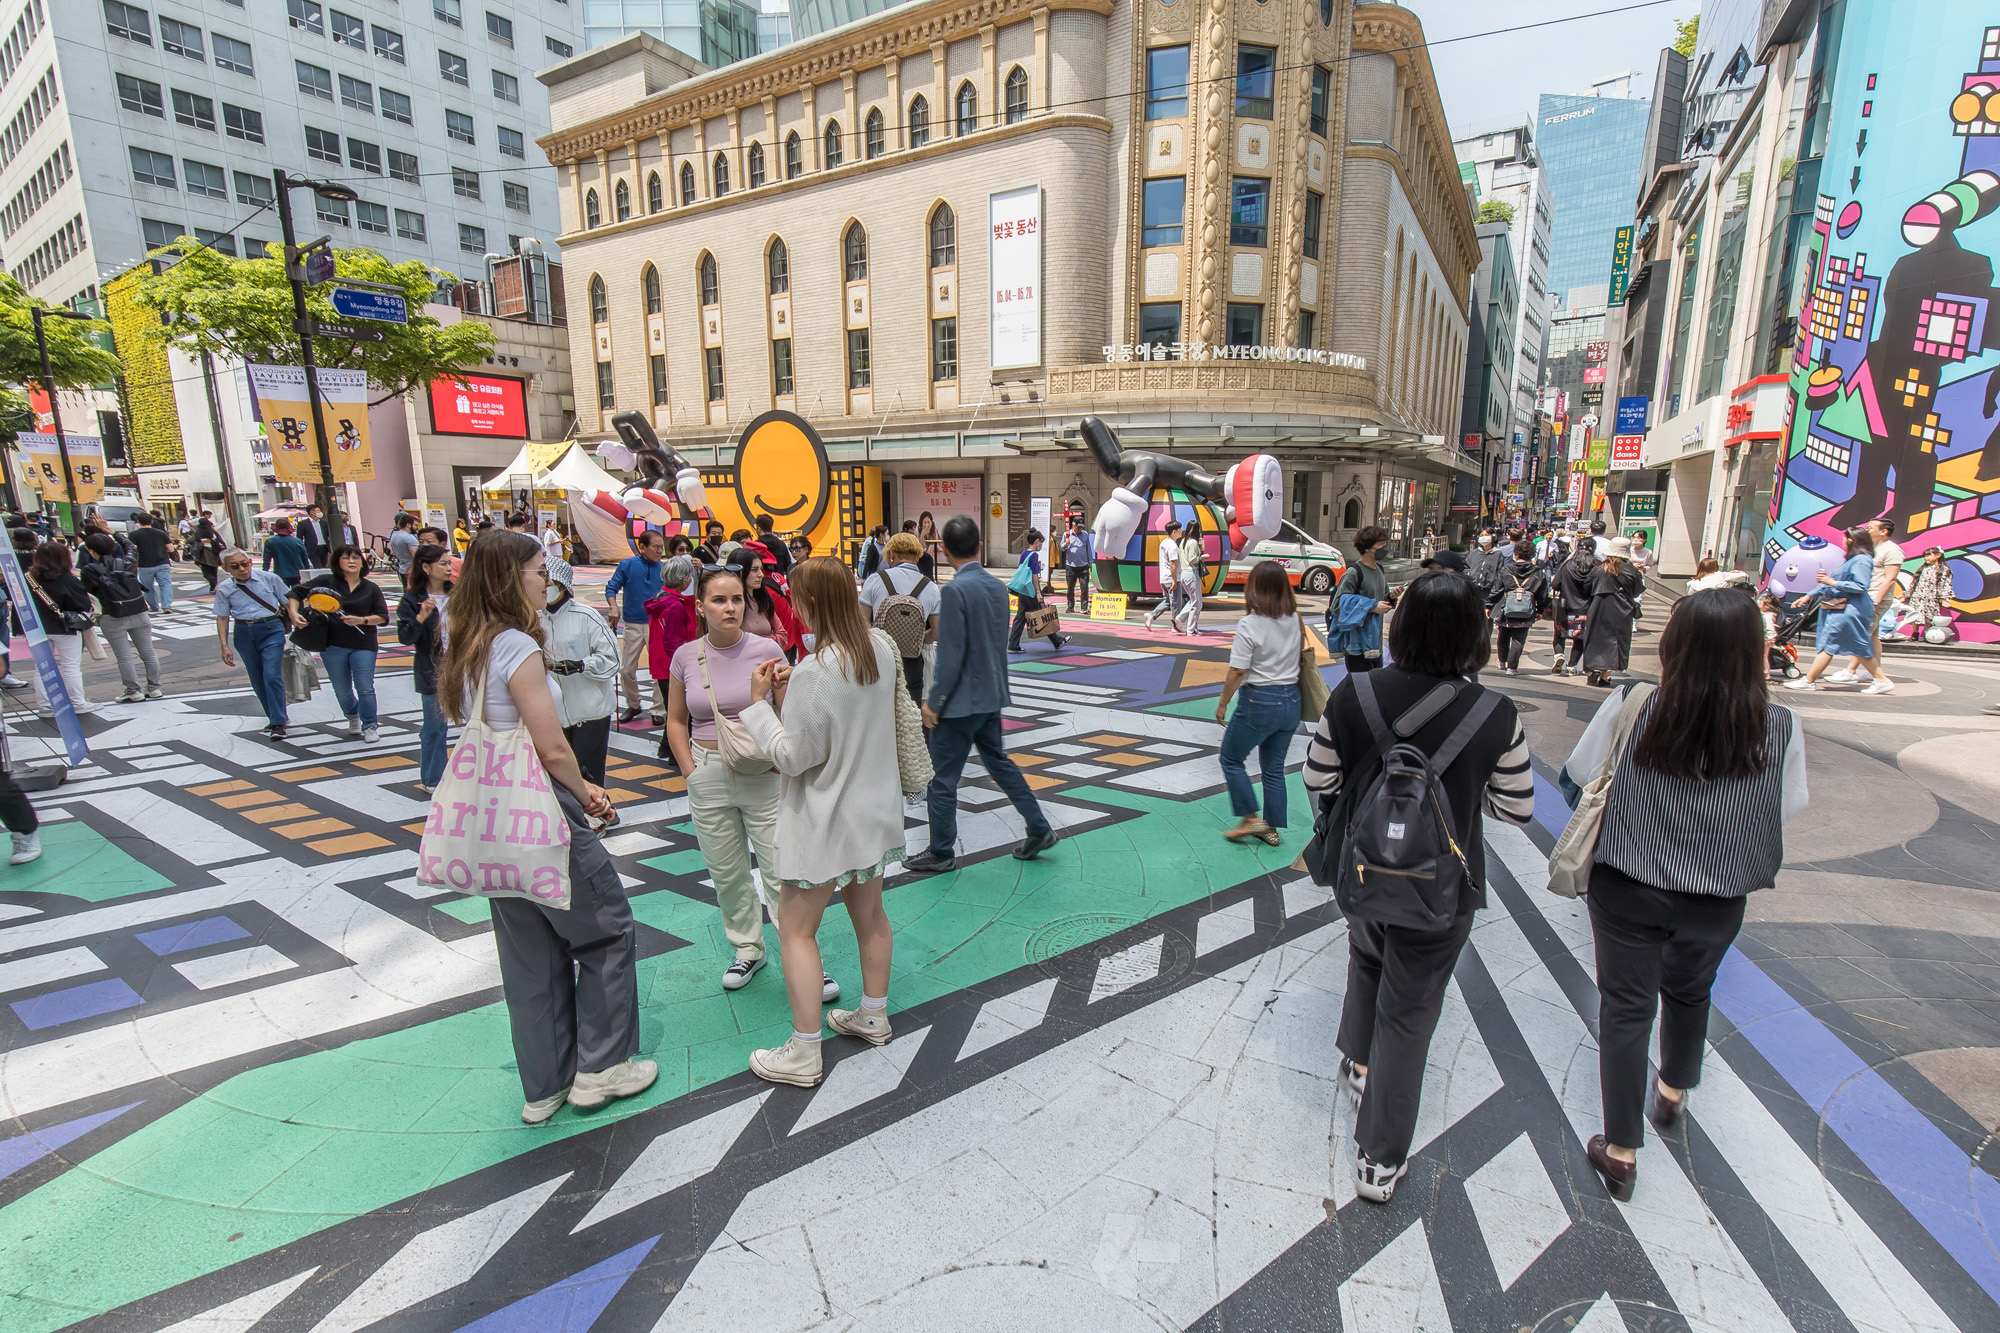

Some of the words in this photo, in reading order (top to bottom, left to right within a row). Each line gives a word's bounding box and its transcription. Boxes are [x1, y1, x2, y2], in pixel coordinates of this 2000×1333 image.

[1545, 107, 1595, 126] FERRUM
[994, 221, 1014, 241] 벚꽃
[1016, 217, 1037, 236] 동산
[1615, 228, 1630, 267] 티안나
[350, 303, 390, 315] Myeongdong
[391, 307, 405, 317] 8-gil
[374, 296, 404, 309] 명동8길
[1102, 341, 1205, 363] 명동예술극장
[1213, 344, 1327, 364] MYEONGDONG
[1587, 341, 1609, 351] 강남
[925, 481, 940, 493] 벚꽃
[941, 481, 957, 493] 동산
[1041, 611, 1059, 624] NIKE
[419, 844, 565, 899] koma
